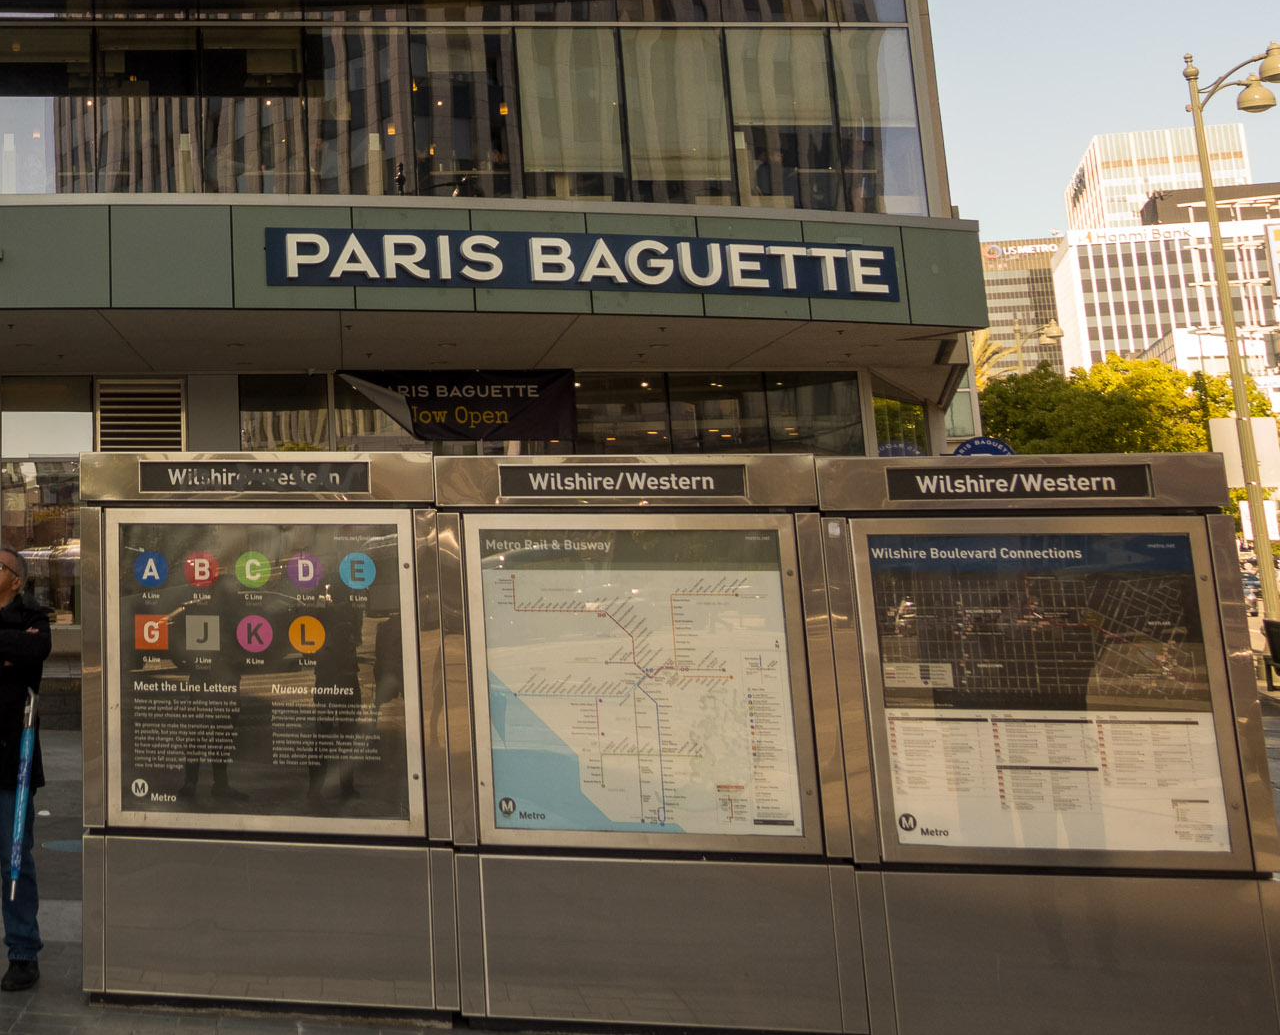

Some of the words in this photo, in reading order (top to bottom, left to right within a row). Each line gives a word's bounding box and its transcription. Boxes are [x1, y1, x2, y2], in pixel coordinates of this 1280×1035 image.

[1097, 229, 1146, 242] Hanmi
[1152, 227, 1192, 239] Bank
[1016, 244, 1058, 254] METRO
[285, 232, 504, 282] PARIS
[529, 237, 890, 294] BAGUETTE
[437, 385, 540, 398] BAGUETTE
[455, 406, 509, 428] Open
[529, 471, 715, 491] Wilshire/Western
[916, 473, 1116, 494] Wilshire/Western
[485, 539, 521, 551] Metro
[524, 539, 548, 551] Rail
[552, 540, 561, 551] &
[564, 540, 611, 553] Busway
[871, 547, 927, 559] Wilshire
[930, 547, 997, 559] Boulevard
[1000, 548, 1082, 559] Connections
[142, 558, 160, 580] A
[194, 558, 210, 580] B
[245, 559, 261, 581] C
[298, 559, 314, 581] D
[350, 560, 365, 582] E
[143, 621, 159, 643] G
[196, 621, 209, 643] J
[247, 623, 264, 645] K
[300, 623, 315, 645] L
[134, 681, 159, 691] Meet
[161, 682, 177, 692] the
[180, 682, 200, 693] Line
[203, 682, 237, 693] Letters
[271, 684, 308, 695] Nuevos
[310, 685, 354, 695] nombres
[151, 793, 176, 802] Metro
[520, 811, 546, 821] Metro
[921, 827, 949, 837] Metro
